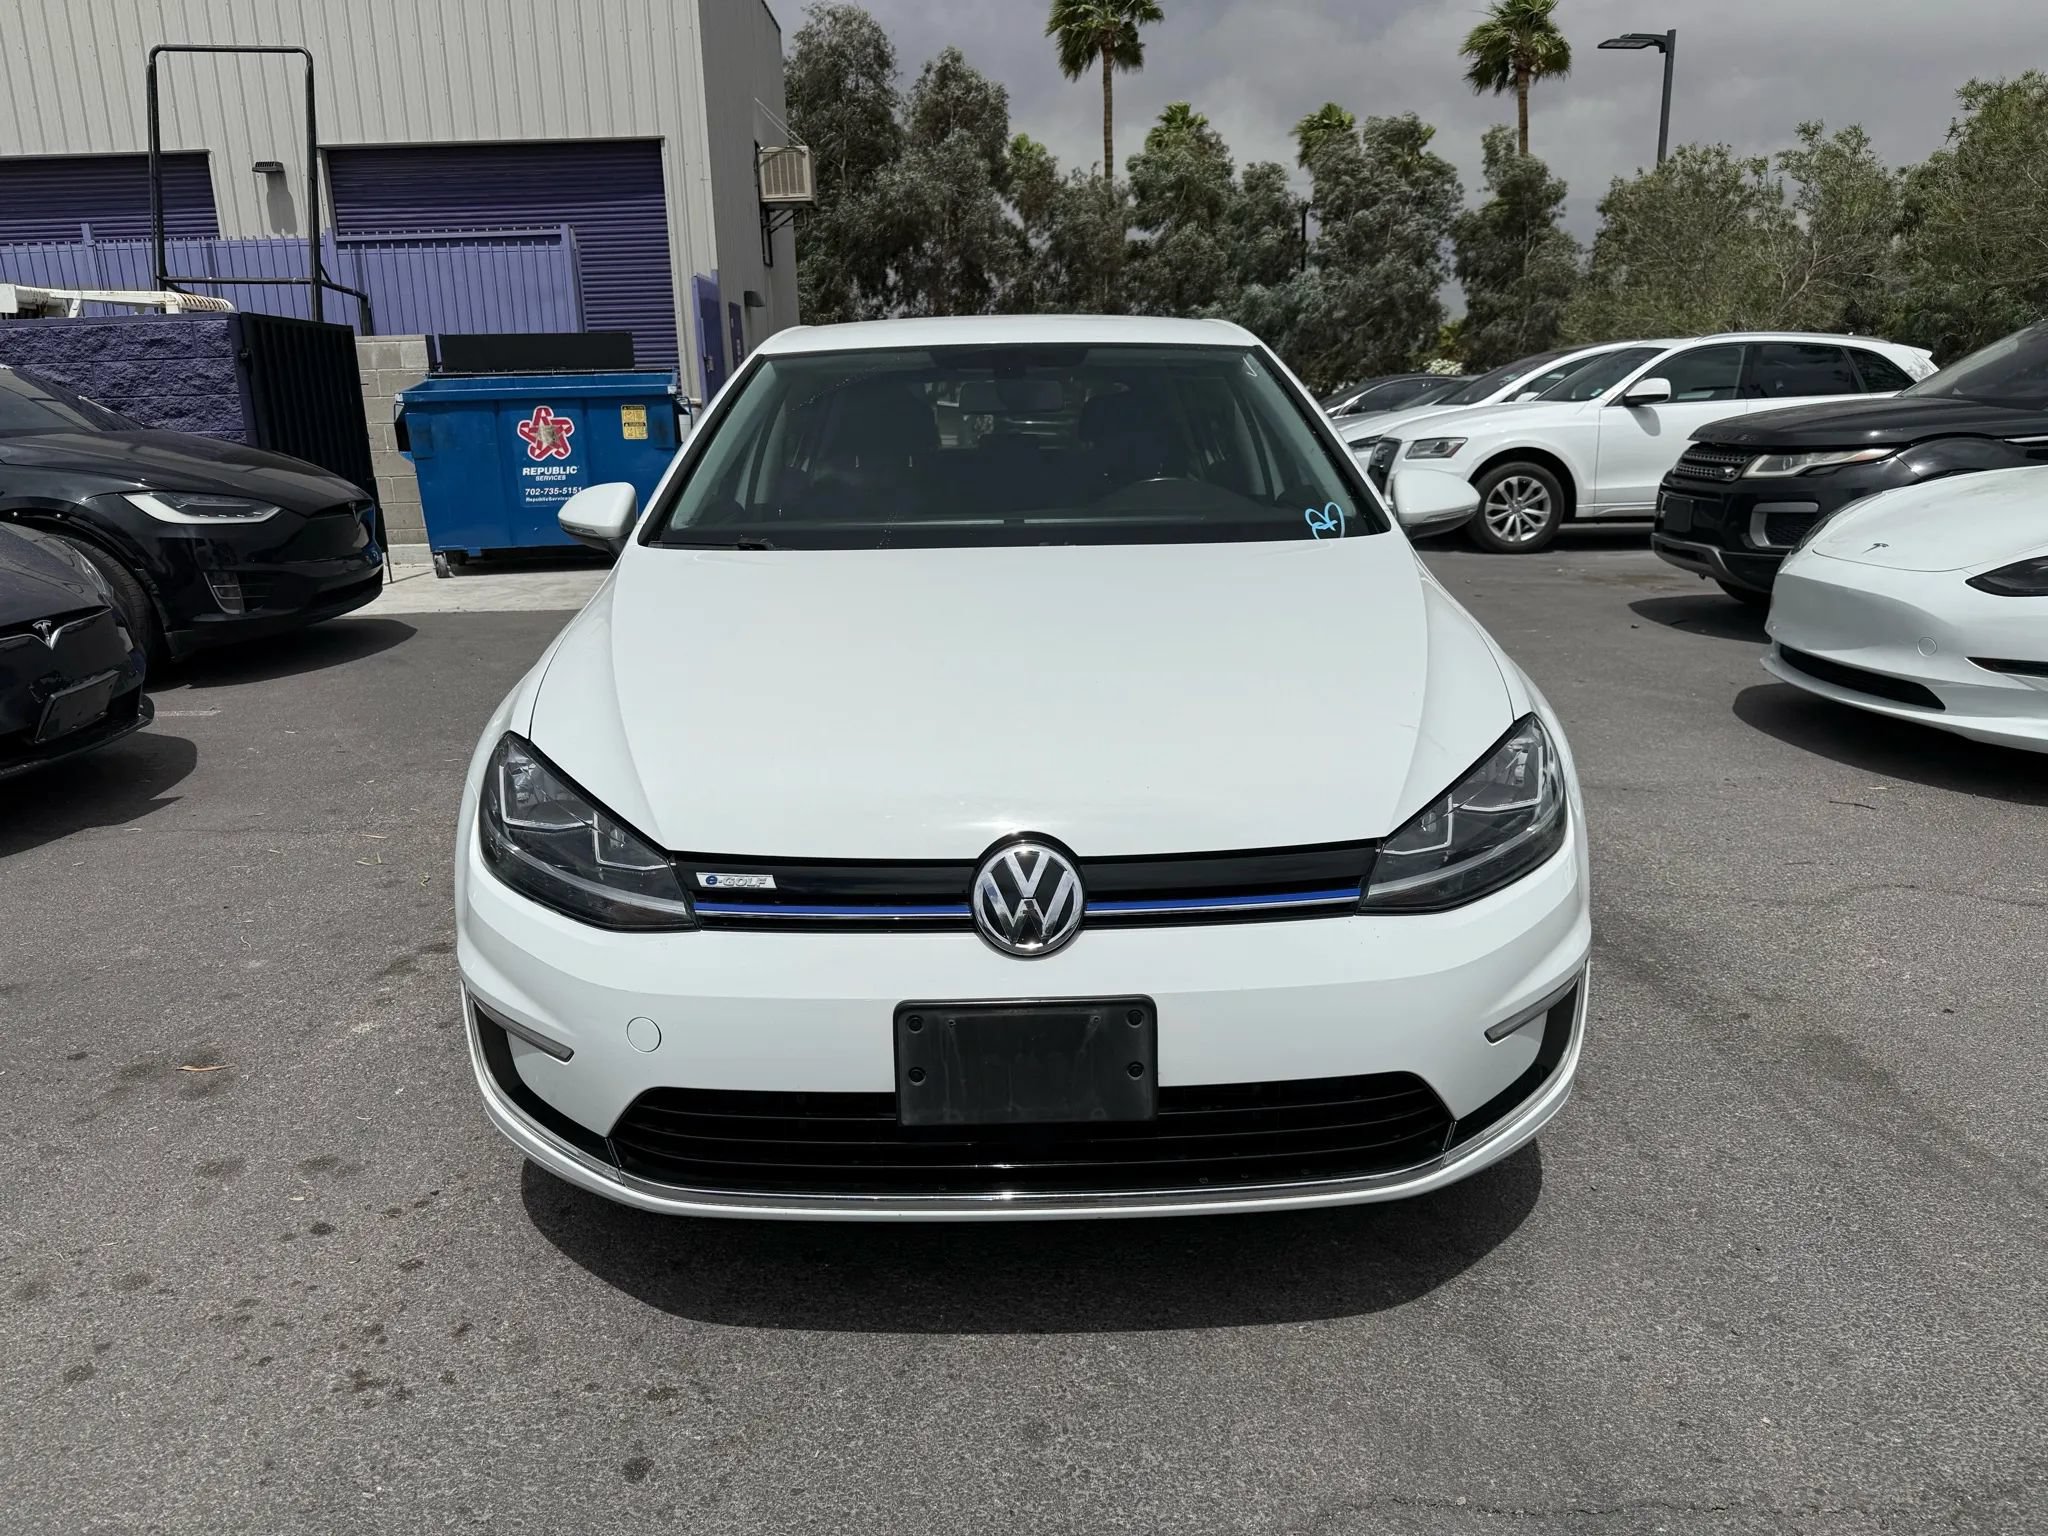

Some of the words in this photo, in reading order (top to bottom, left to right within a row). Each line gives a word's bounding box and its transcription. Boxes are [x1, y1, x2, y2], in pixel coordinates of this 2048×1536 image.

[522, 465, 578, 476] REPUBLIC
[525, 487, 582, 495] 702-735-5151
[705, 874, 767, 888] e-GOLF
[979, 846, 1078, 948] VW
